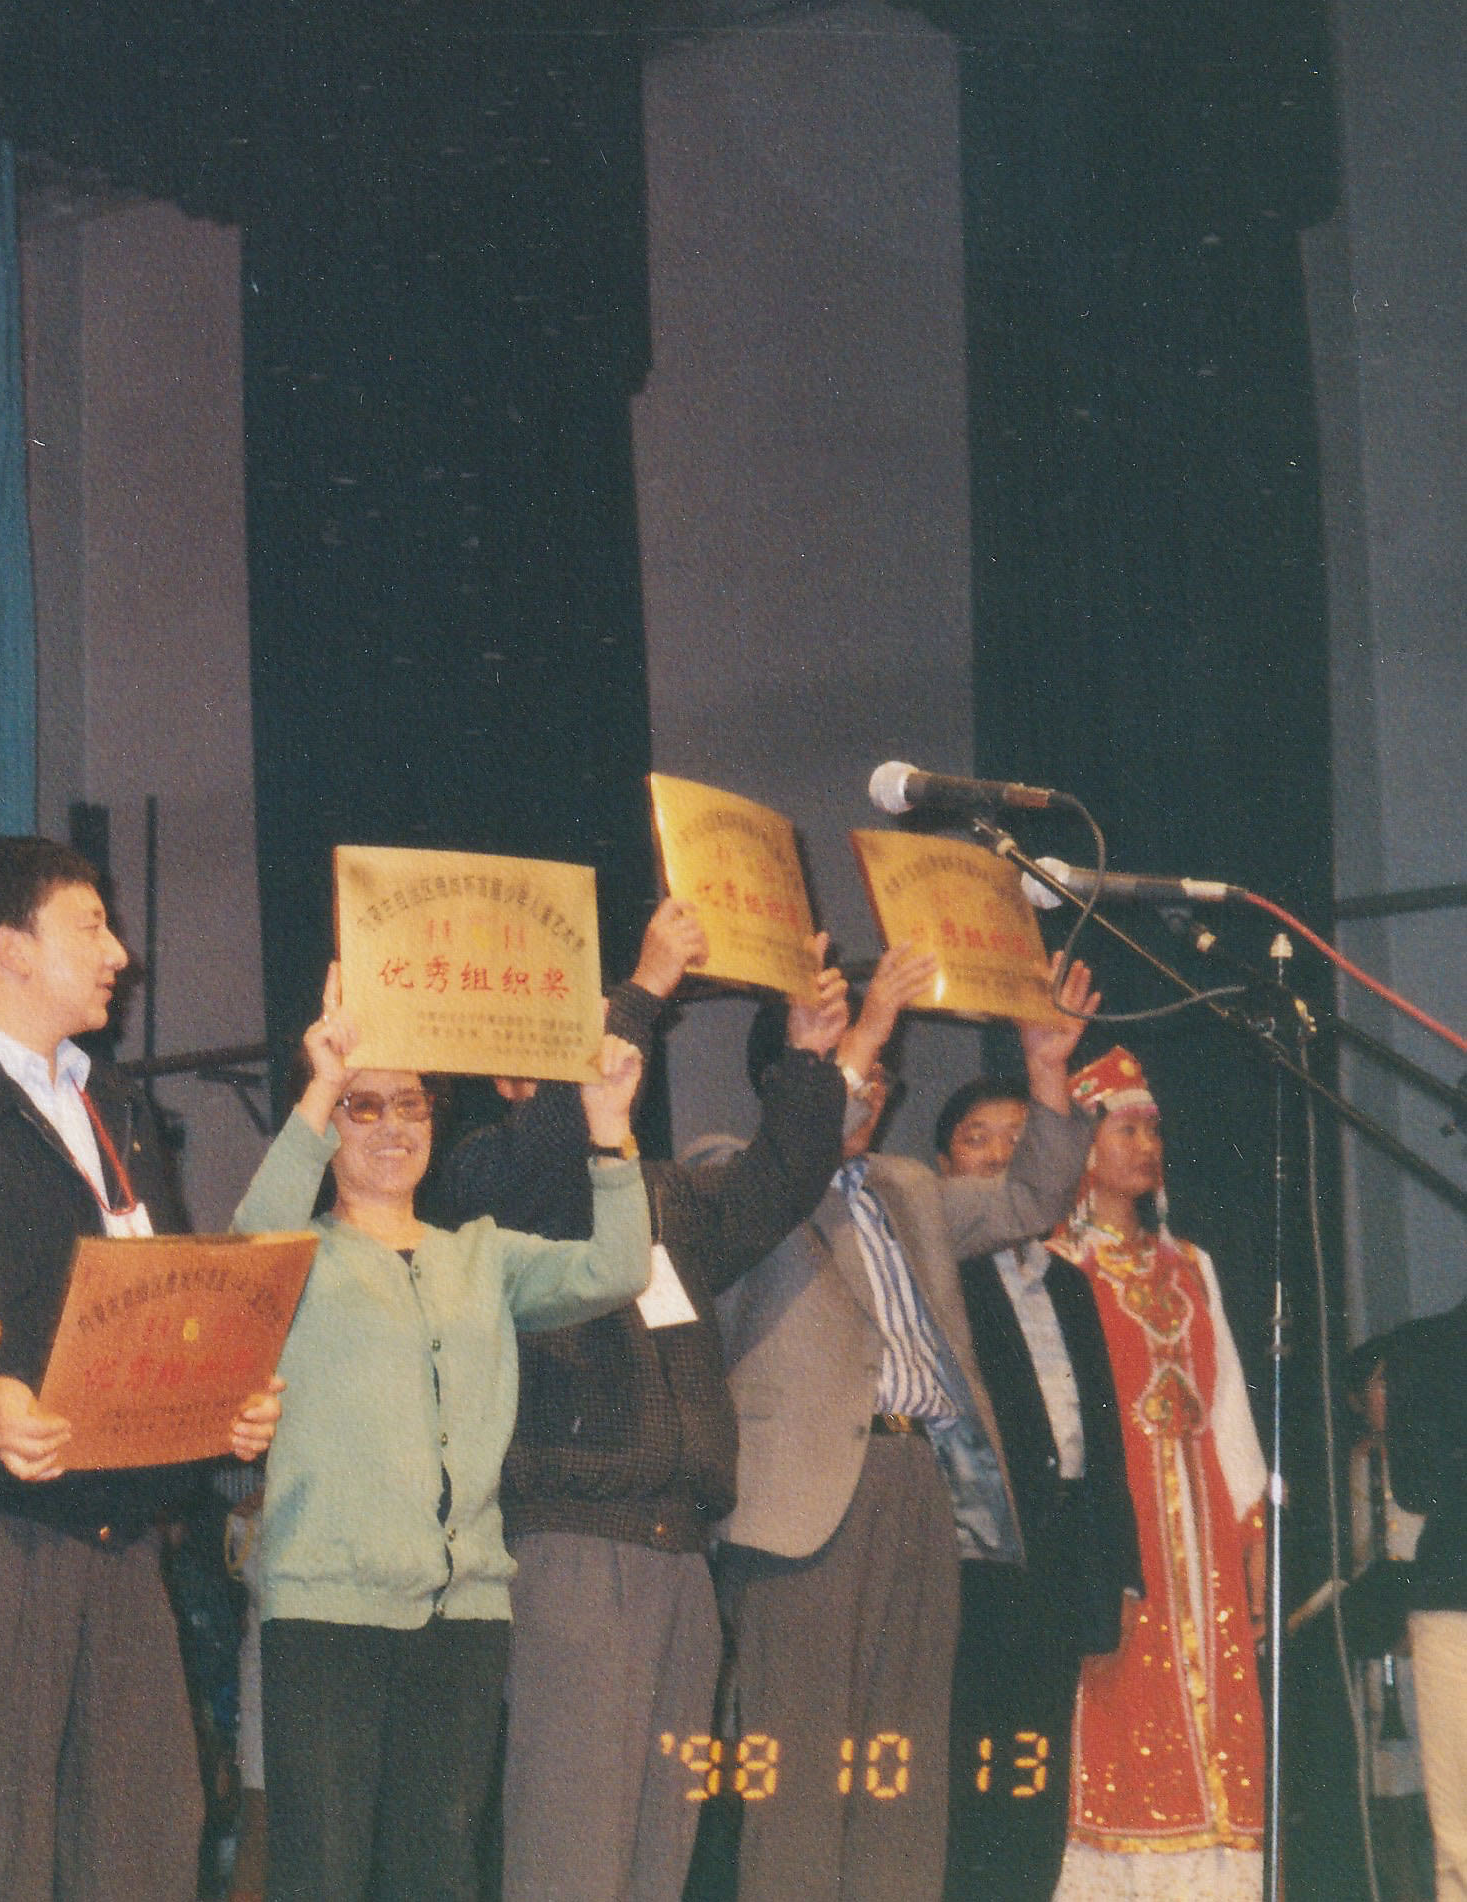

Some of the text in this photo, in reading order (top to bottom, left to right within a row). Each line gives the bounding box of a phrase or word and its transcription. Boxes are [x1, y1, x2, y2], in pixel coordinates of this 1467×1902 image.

[379, 955, 570, 999] 优秀组织奖
